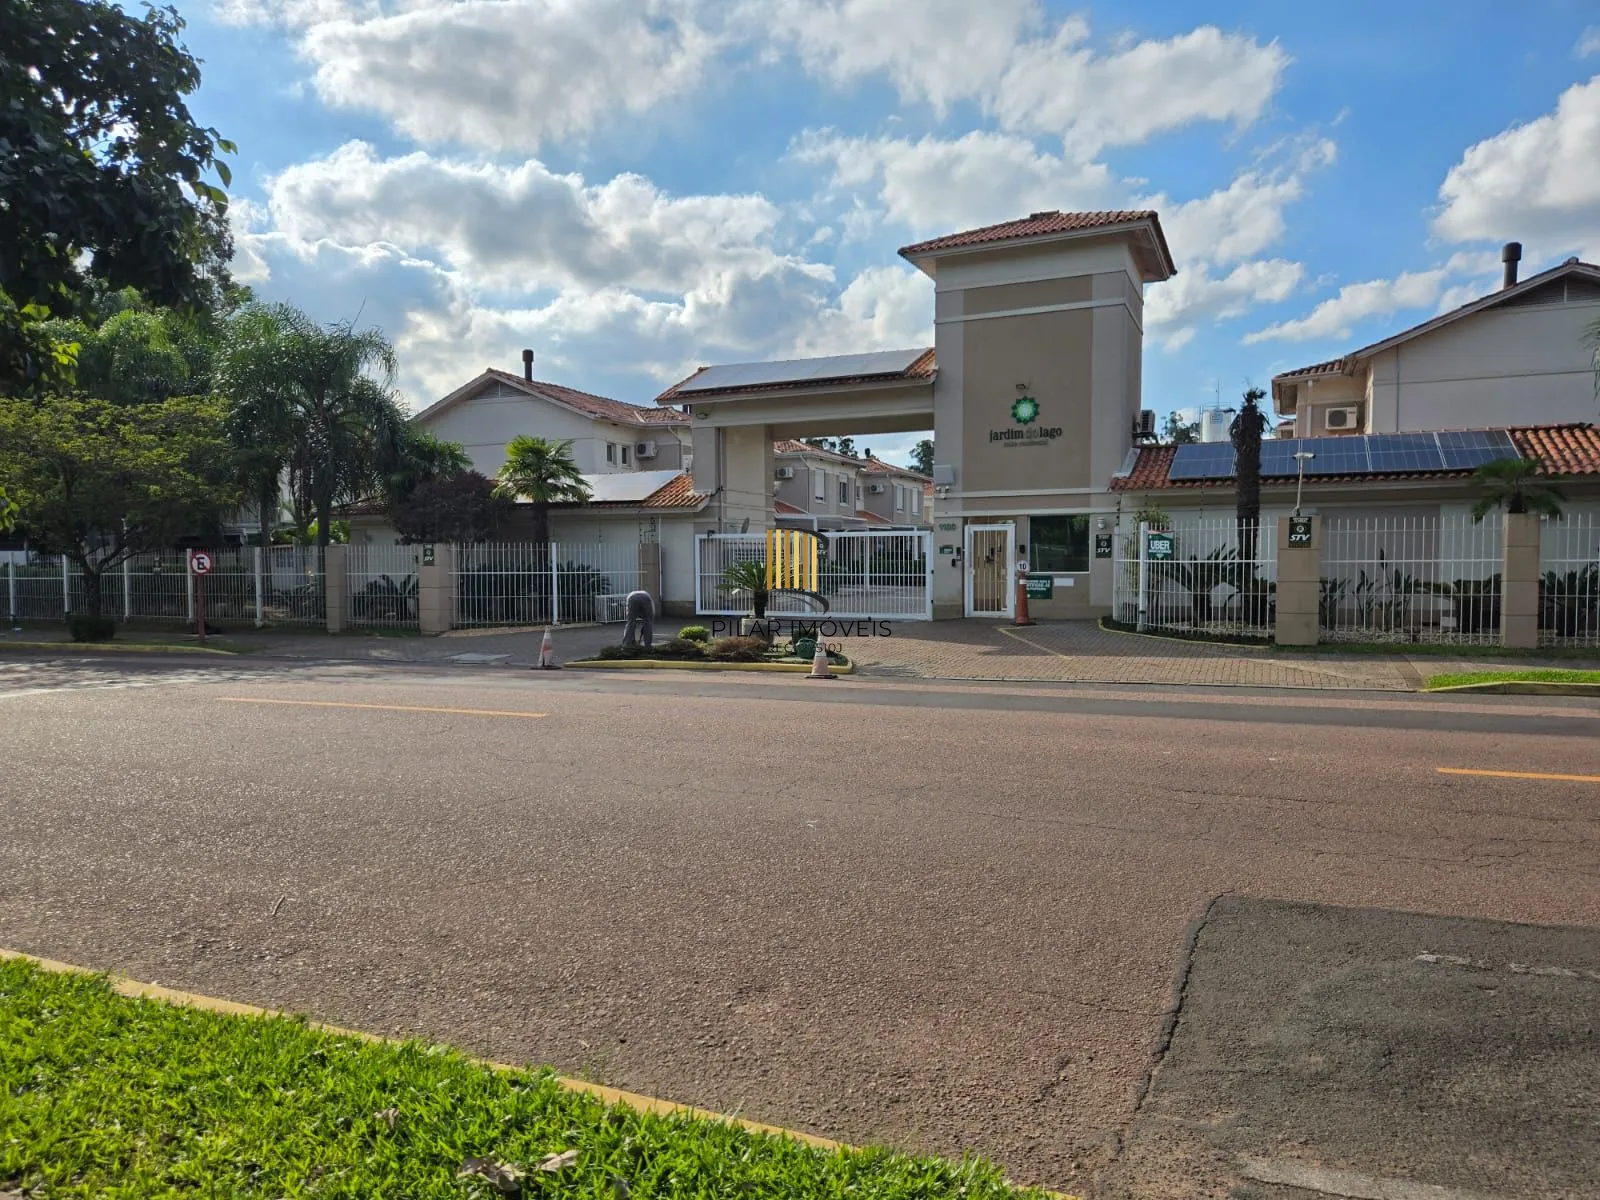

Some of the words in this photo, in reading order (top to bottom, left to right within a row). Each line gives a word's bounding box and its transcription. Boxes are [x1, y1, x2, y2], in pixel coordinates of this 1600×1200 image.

[989, 427, 1024, 443] jardim
[1040, 426, 1062, 439] lago
[1150, 540, 1170, 550] UBER
[1019, 562, 1027, 570] 10
